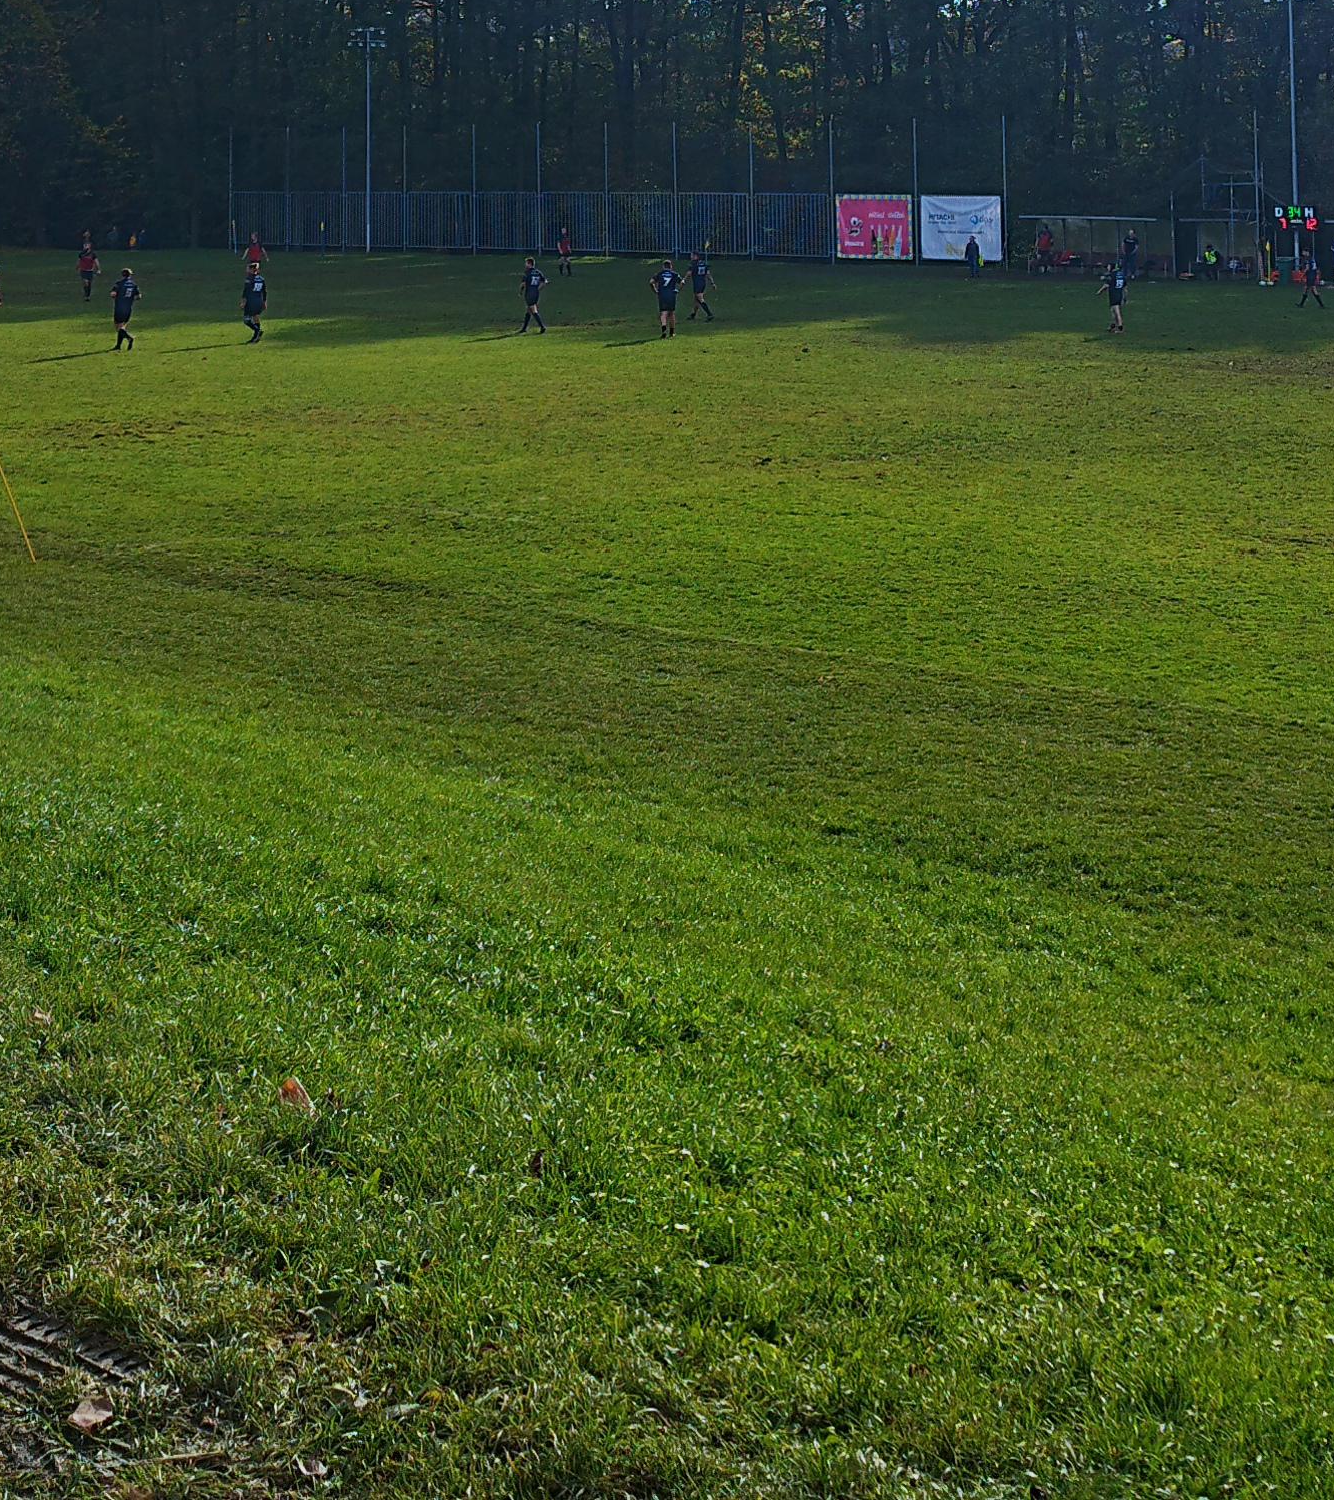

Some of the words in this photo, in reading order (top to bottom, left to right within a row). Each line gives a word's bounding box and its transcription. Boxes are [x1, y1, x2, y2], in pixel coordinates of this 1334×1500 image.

[1274, 207, 1283, 217] D
[1287, 206, 1301, 218] 34
[1304, 207, 1314, 218] H
[662, 277, 672, 287] 7
